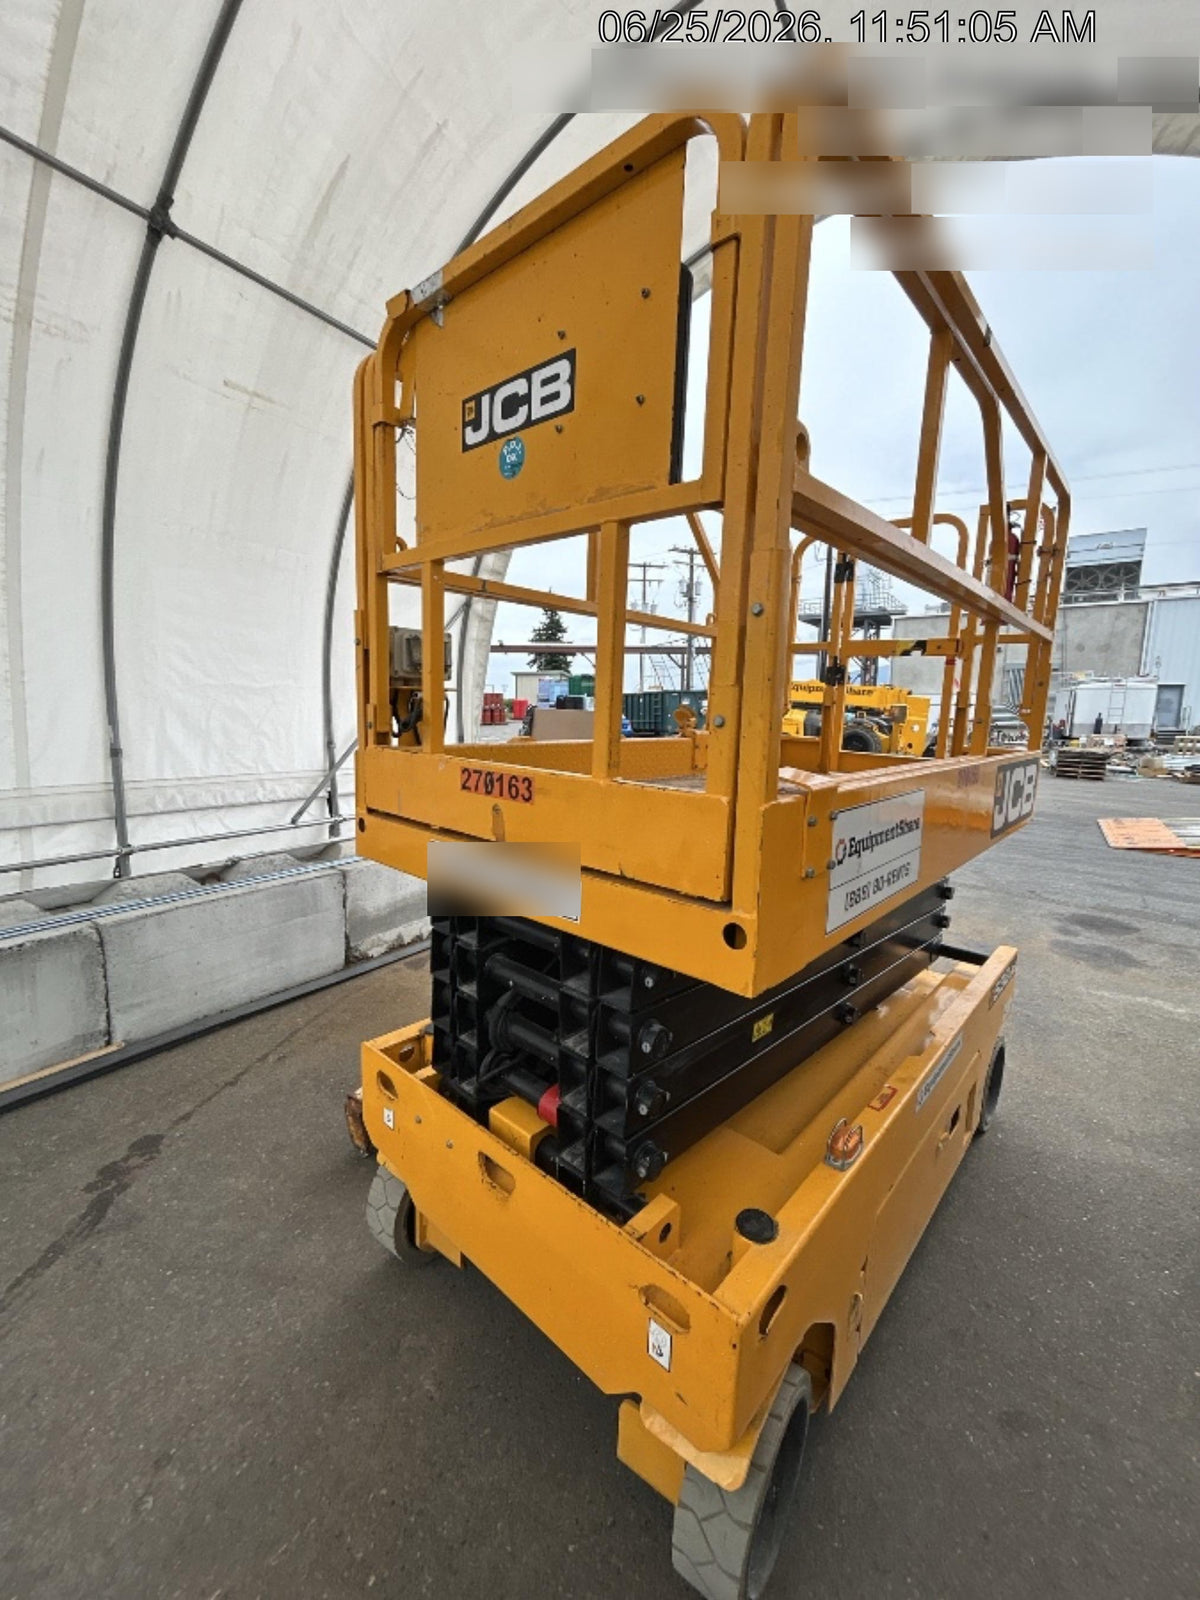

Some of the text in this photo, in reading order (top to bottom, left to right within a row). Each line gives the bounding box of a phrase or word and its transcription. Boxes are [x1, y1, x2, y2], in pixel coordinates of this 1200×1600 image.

[464, 358, 572, 446] JCB
[461, 768, 532, 803] 270163
[993, 764, 1037, 831] JCB
[847, 817, 920, 859] EquipmentShare
